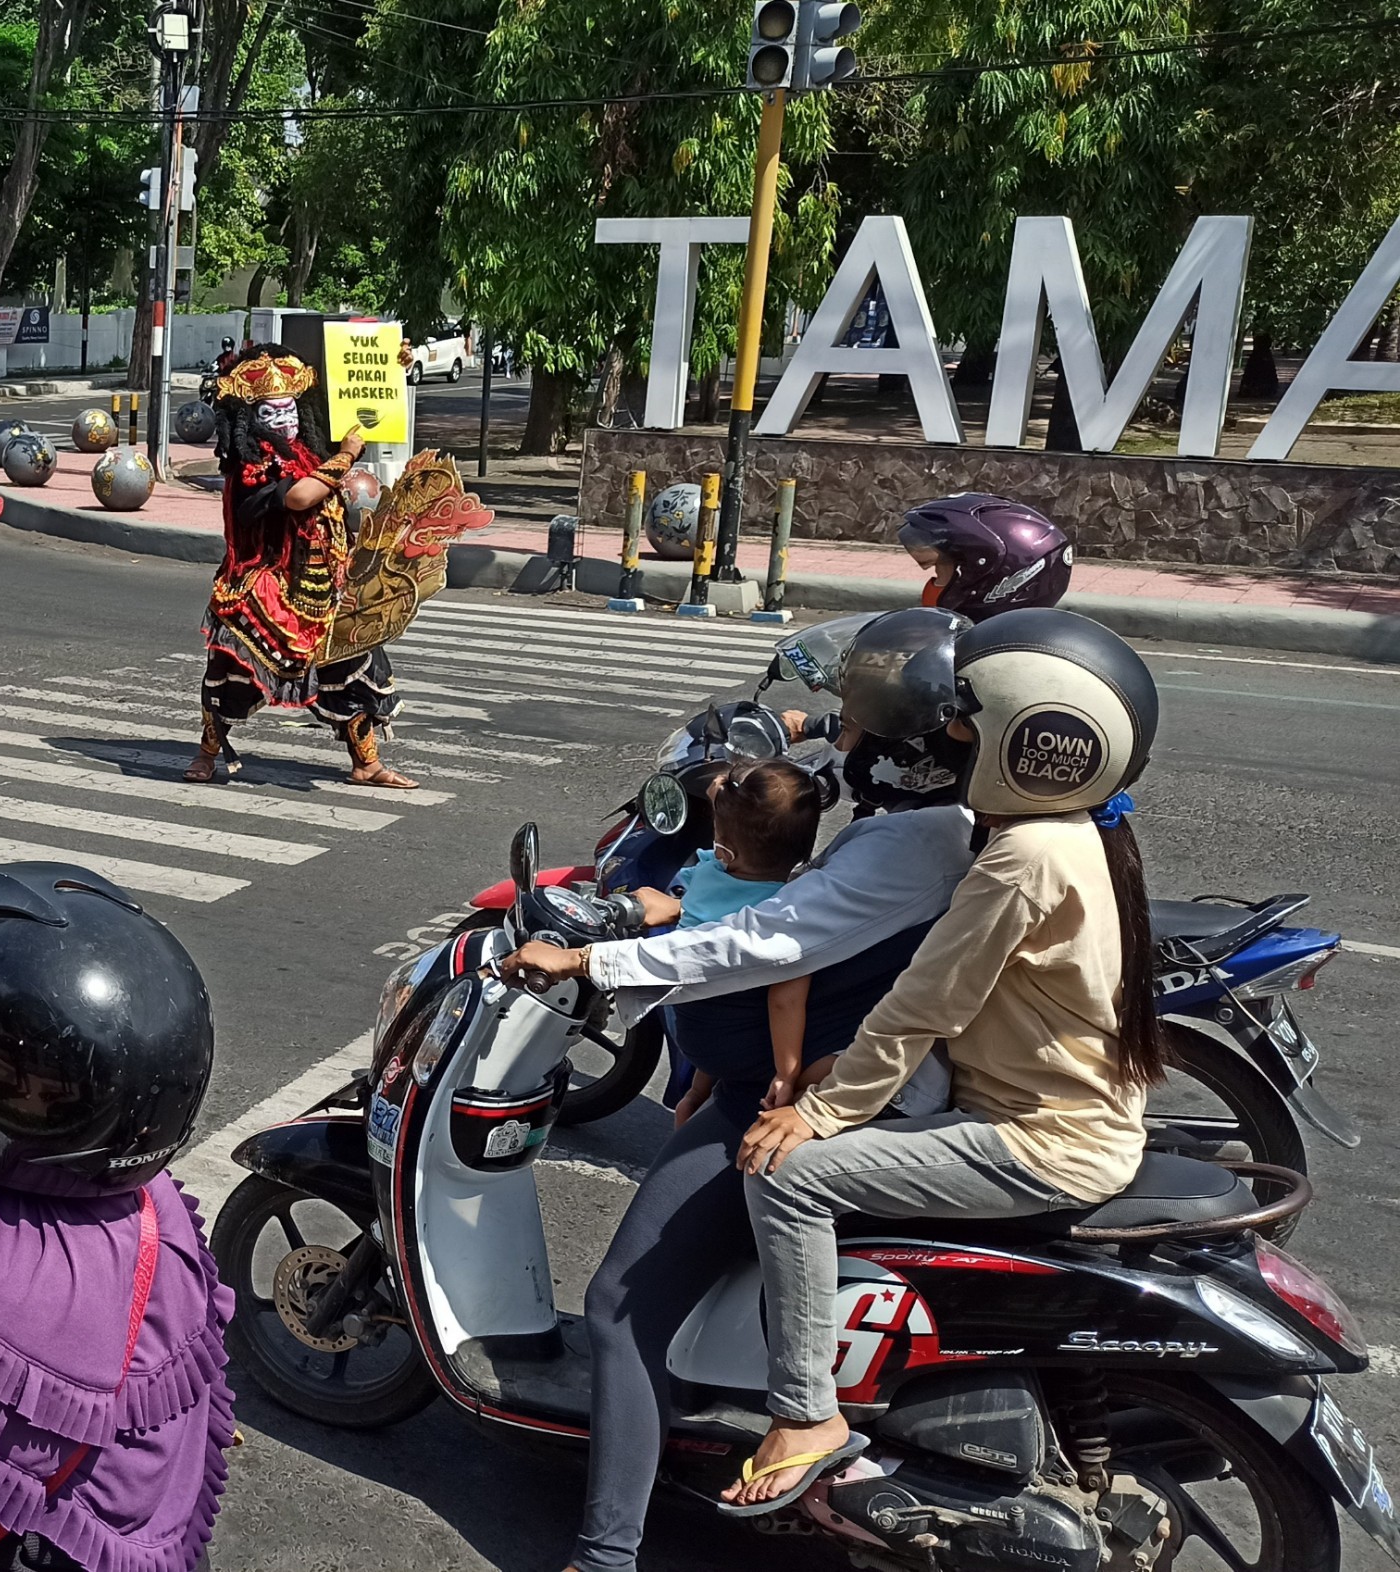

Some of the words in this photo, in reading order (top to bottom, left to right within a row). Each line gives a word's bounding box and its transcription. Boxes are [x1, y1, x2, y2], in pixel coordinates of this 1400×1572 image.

[22, 326, 48, 334] SPINNO
[350, 336, 379, 348] YUK
[343, 352, 388, 365] SELALU
[348, 369, 386, 382] PAKAI
[339, 387, 398, 400] MASKER!
[1022, 728, 1030, 746] I
[1037, 731, 1093, 757] OWN
[1022, 747, 1048, 762] TOO
[1051, 753, 1089, 768] MUCH
[1016, 757, 1086, 783] BLACK
[1057, 1331, 1218, 1358] Scoopy
[1002, 1543, 1072, 1567] HONDA
